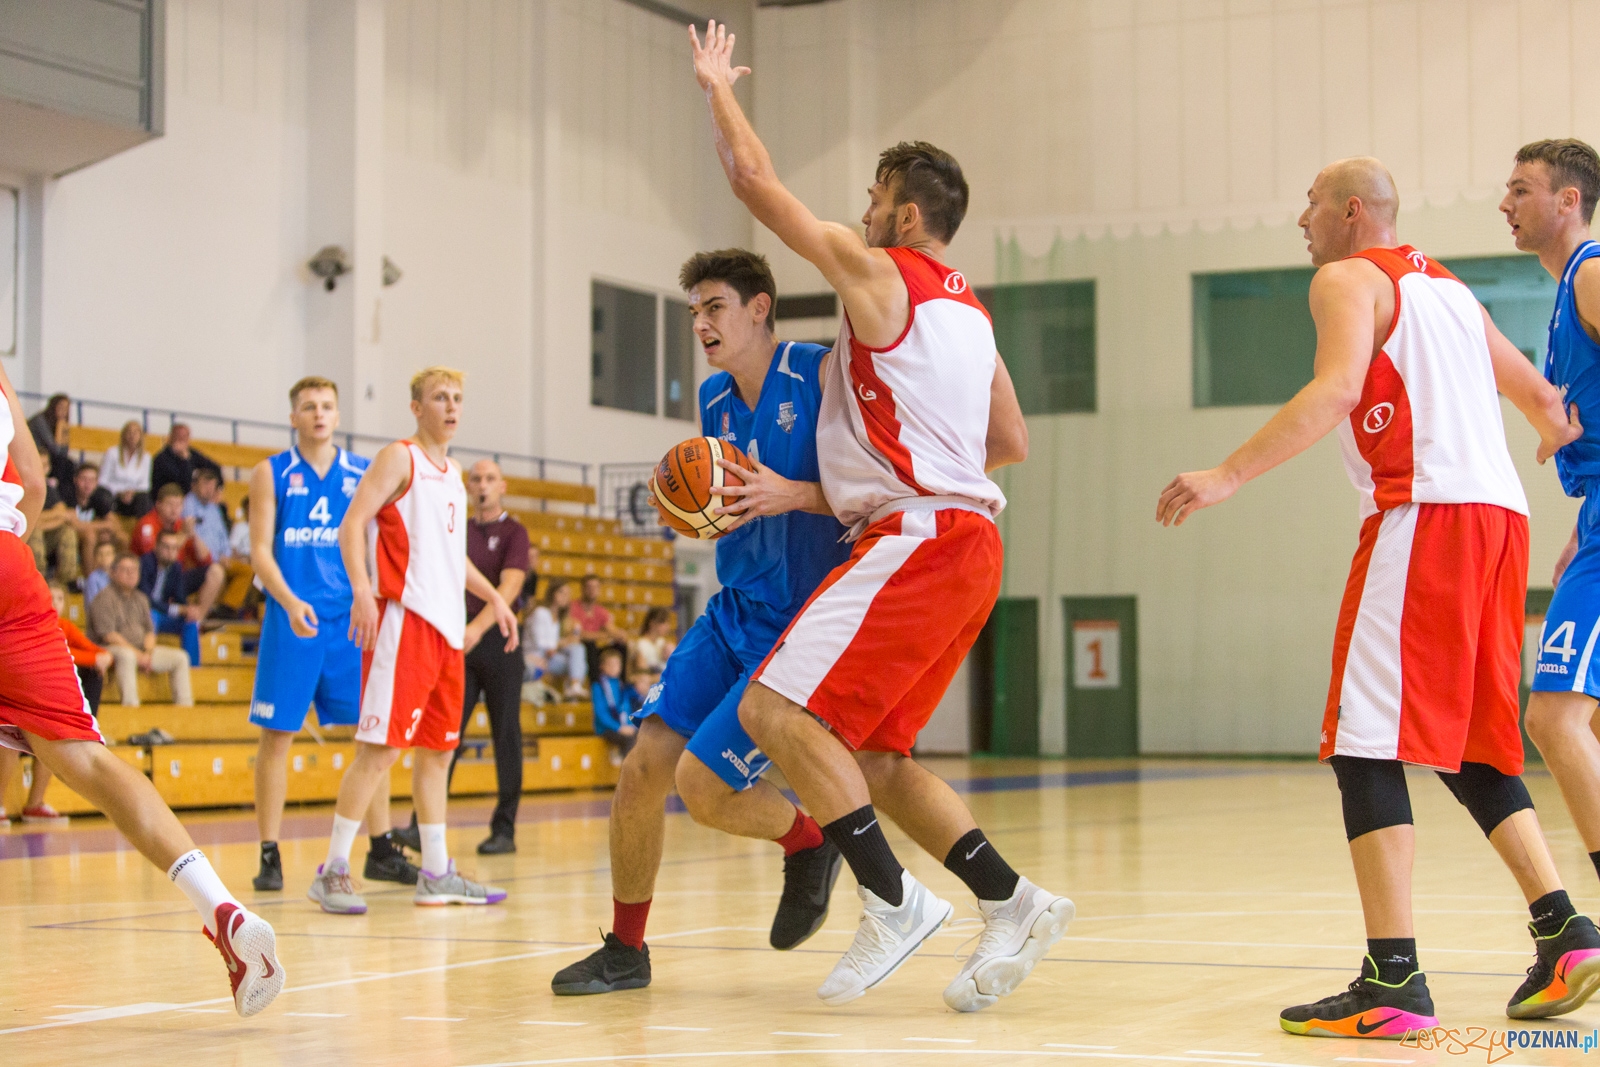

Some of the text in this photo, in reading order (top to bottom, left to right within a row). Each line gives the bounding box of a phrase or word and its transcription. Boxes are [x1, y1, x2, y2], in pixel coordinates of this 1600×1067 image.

[308, 496, 332, 526] 4
[447, 502, 455, 534] 3
[1086, 639, 1107, 680] 1
[404, 707, 422, 741] 3
